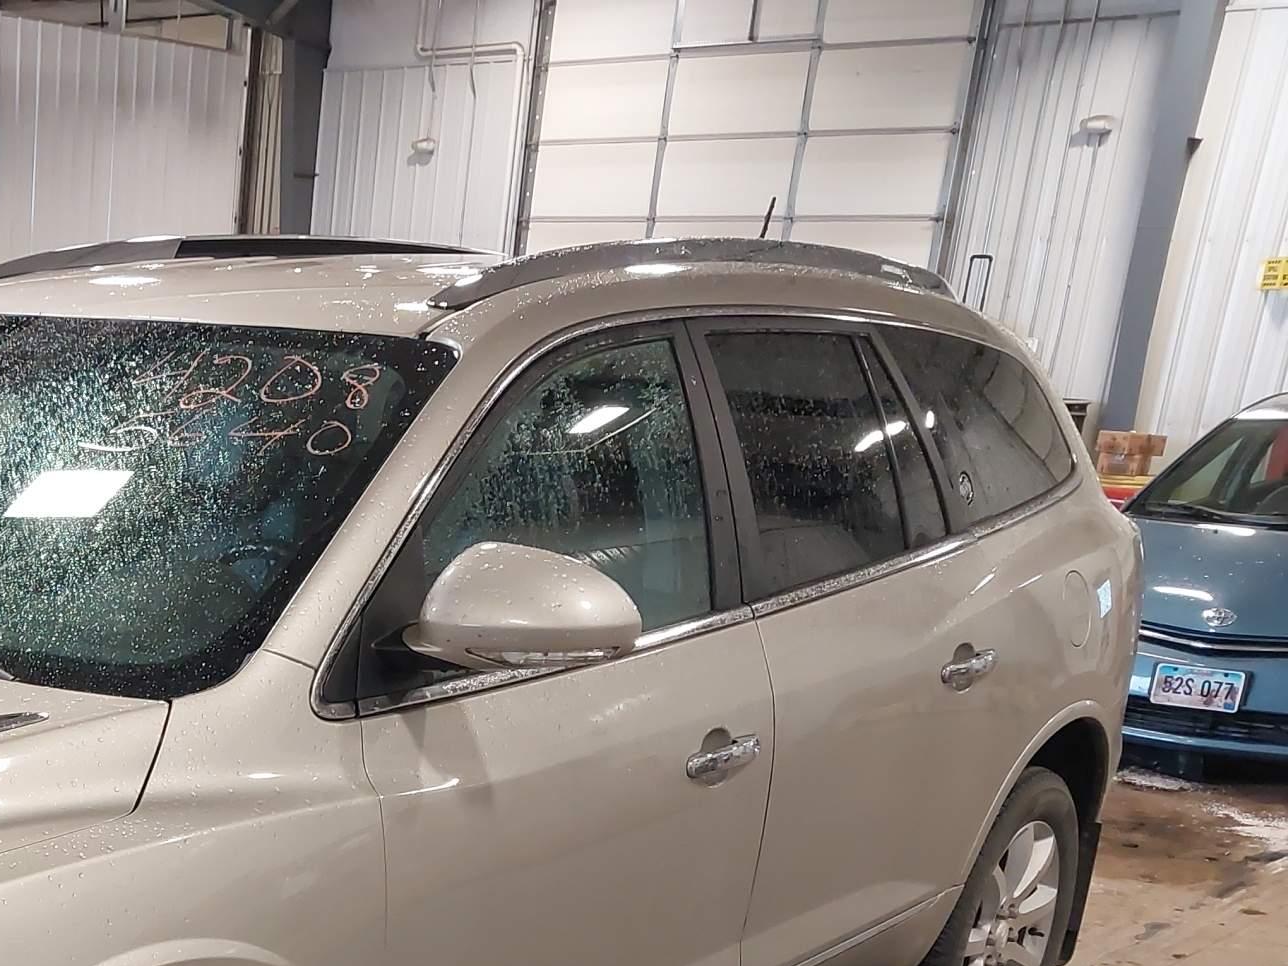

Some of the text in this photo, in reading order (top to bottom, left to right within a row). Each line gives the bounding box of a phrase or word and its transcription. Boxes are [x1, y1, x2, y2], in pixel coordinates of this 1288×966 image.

[133, 349, 381, 408] 4208
[1162, 675, 1235, 700] 52S 077
